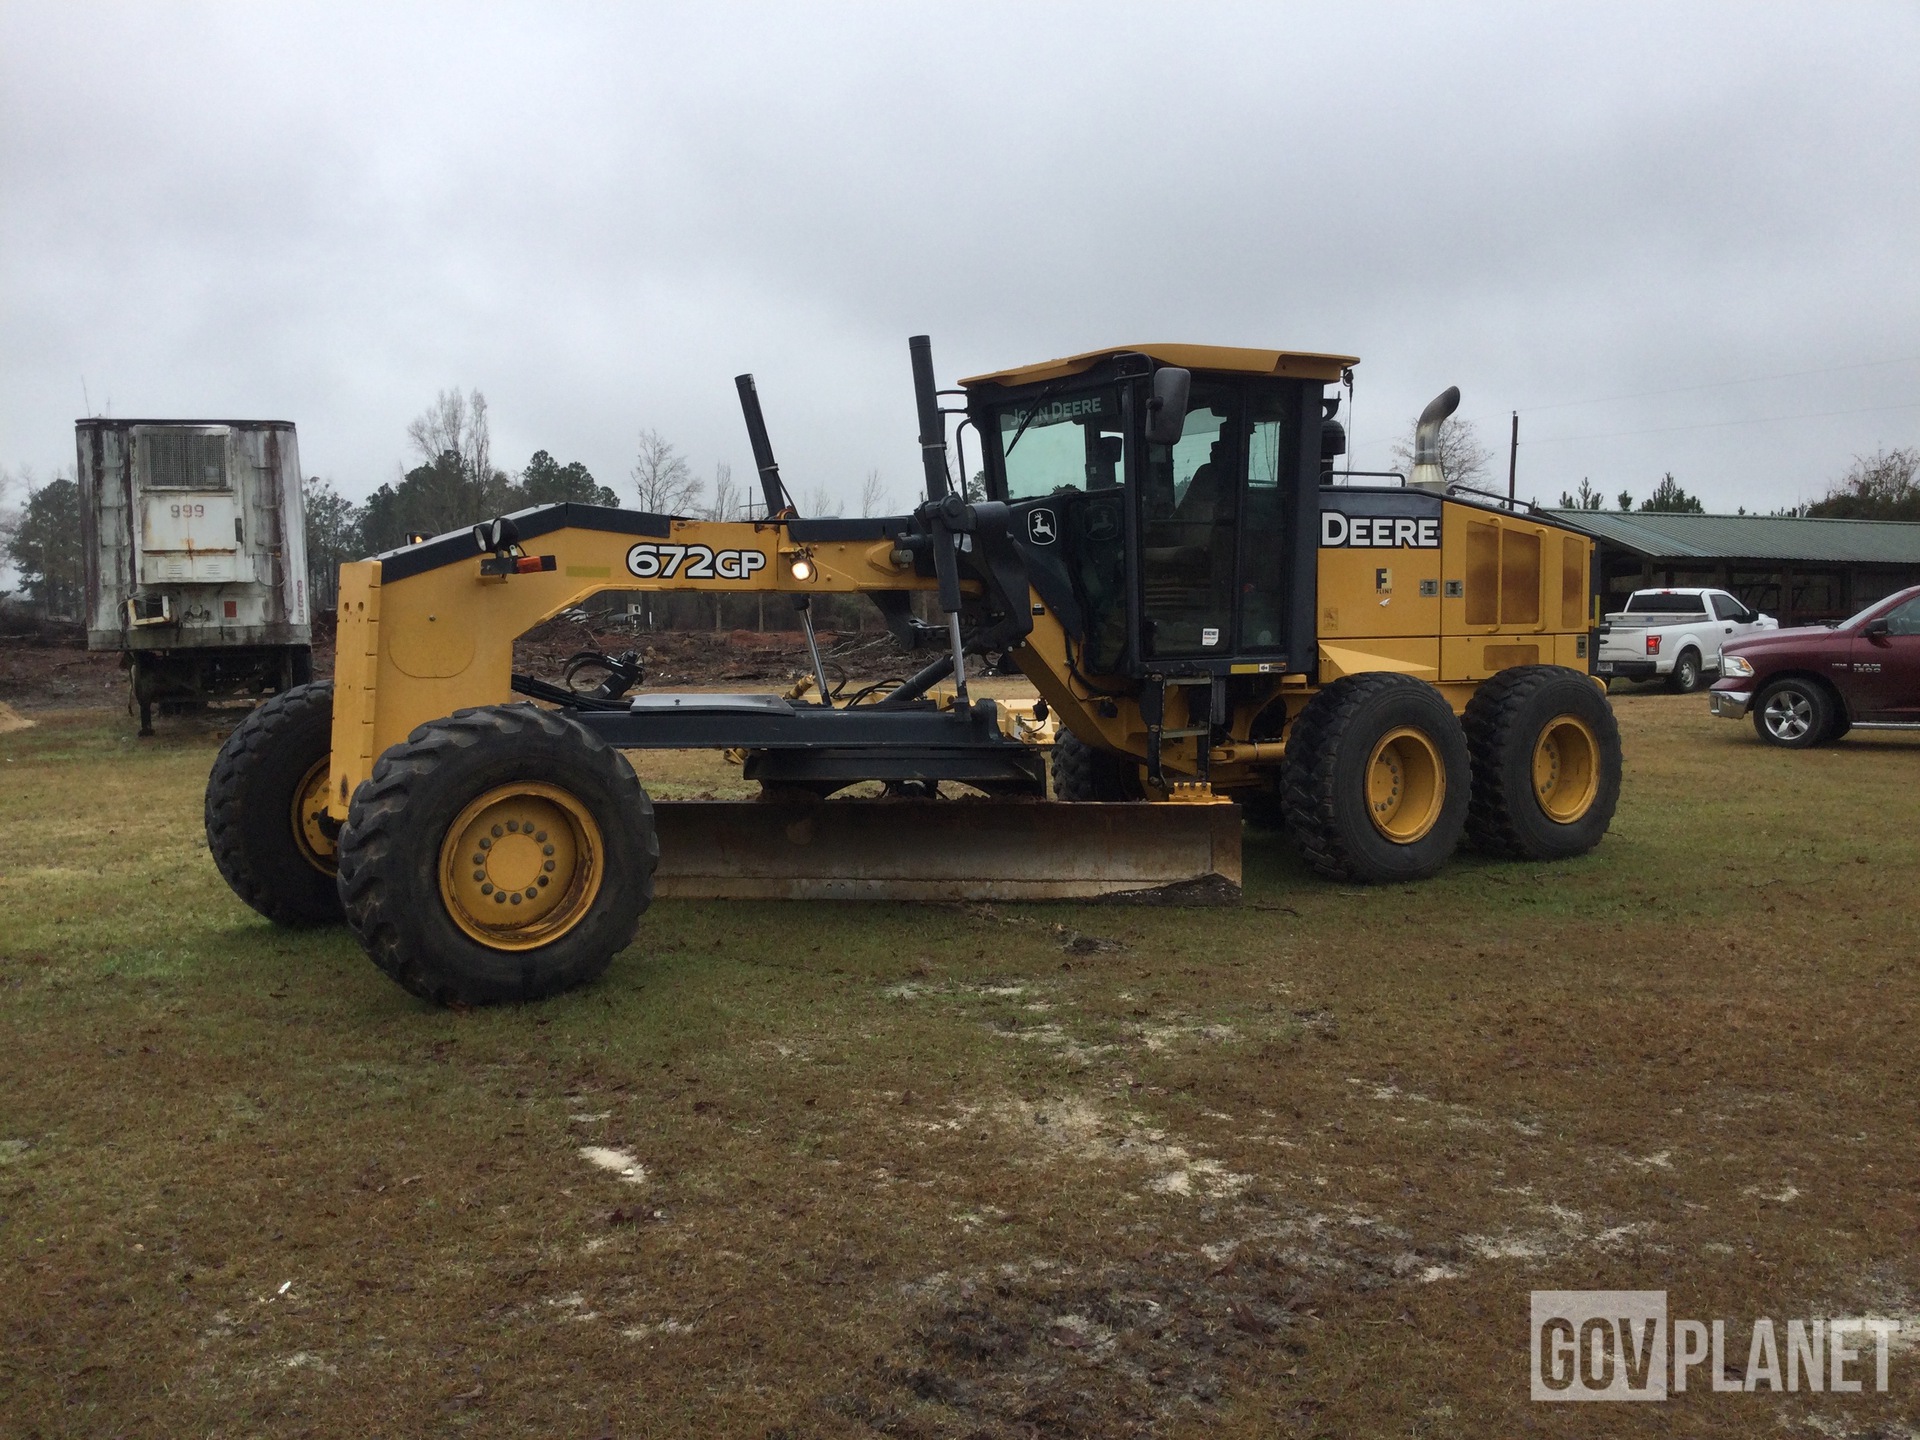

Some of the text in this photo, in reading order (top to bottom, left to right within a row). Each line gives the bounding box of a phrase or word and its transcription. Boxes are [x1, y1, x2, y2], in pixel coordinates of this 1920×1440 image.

[1051, 397, 1102, 419] DEERE
[170, 504, 204, 518] 999
[1321, 511, 1438, 546] DEERE
[627, 543, 766, 578] 672GP
